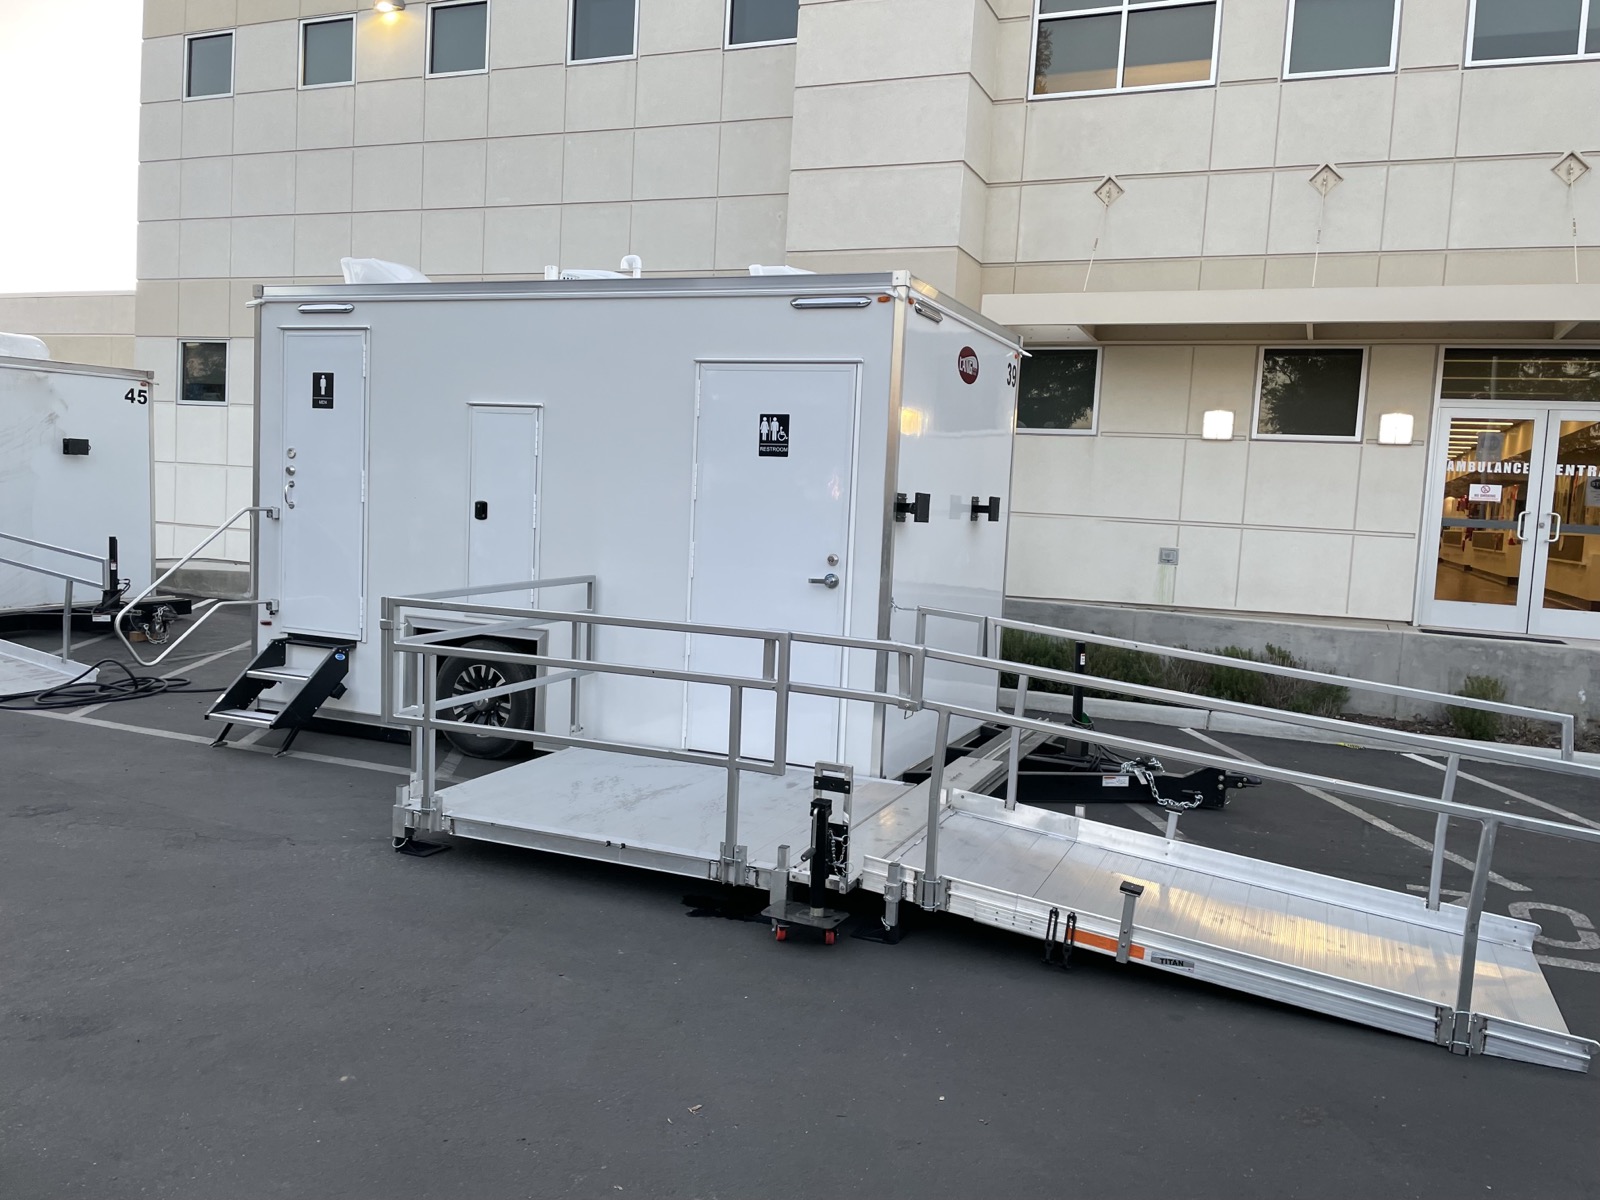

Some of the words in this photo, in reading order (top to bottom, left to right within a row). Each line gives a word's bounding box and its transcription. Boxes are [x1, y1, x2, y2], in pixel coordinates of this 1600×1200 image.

[1006, 362, 1017, 387] 39
[124, 387, 148, 405] 45
[1446, 460, 1530, 475] AMBULANCE
[1555, 463, 1600, 477] ENTR
[1160, 957, 1184, 967] TITAN
